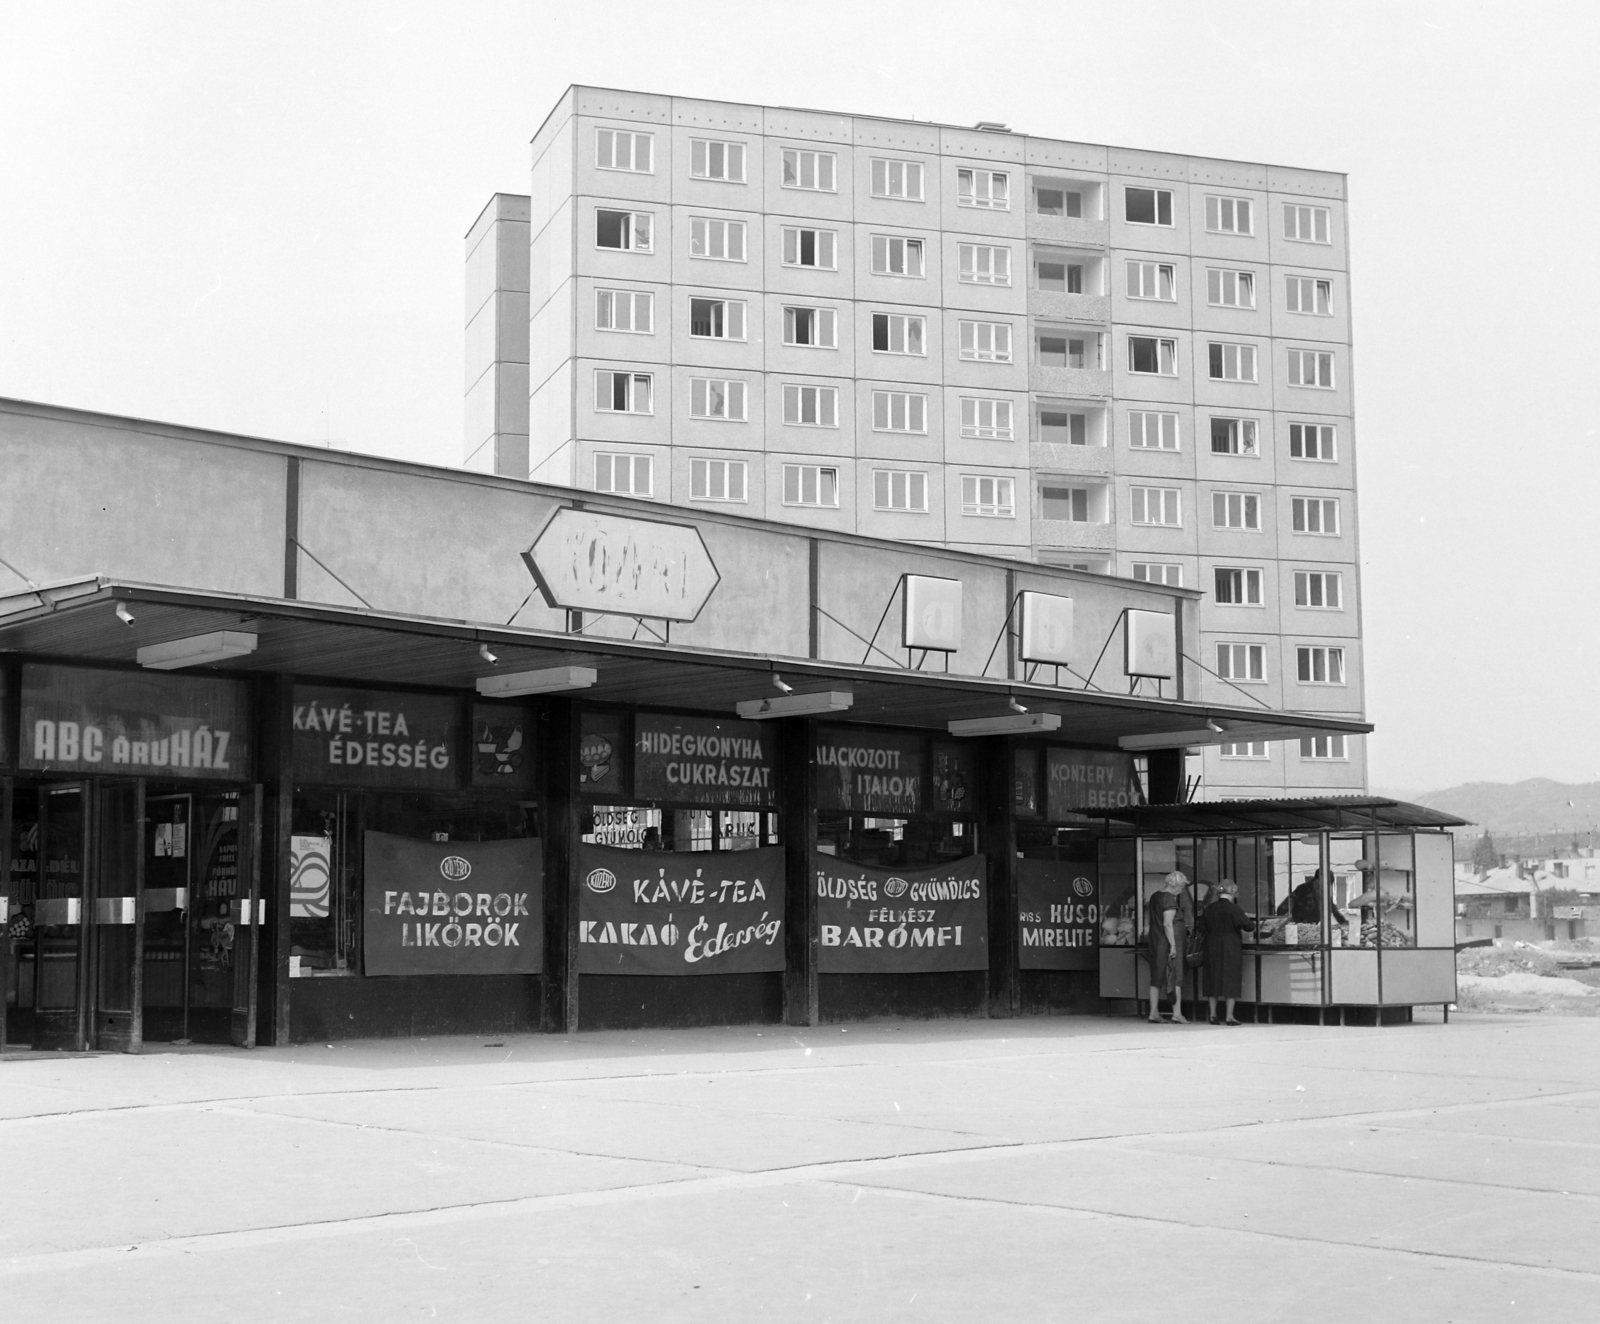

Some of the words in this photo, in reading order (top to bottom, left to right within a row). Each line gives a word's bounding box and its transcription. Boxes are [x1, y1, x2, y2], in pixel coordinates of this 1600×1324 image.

[34, 719, 103, 763] ABC
[330, 736, 449, 770] ÉDESSÉG
[641, 731, 763, 760] HIDEGKONYHA
[666, 760, 770, 788] CUKRÁSZAT
[857, 774, 916, 796] ITALOK
[1050, 763, 1114, 784] KONZERV
[10, 858, 37, 872] AZA
[633, 868, 766, 904] KÁVÉ-TEA
[909, 876, 980, 902] GYÜMÖLCS
[384, 890, 529, 916] FAJBOROK
[868, 908, 936, 923] FÉLKÉSZ
[402, 916, 520, 947] LIKÖRÖK
[579, 913, 679, 946] KAKAÓ
[1022, 927, 1093, 948] MIRELITE
